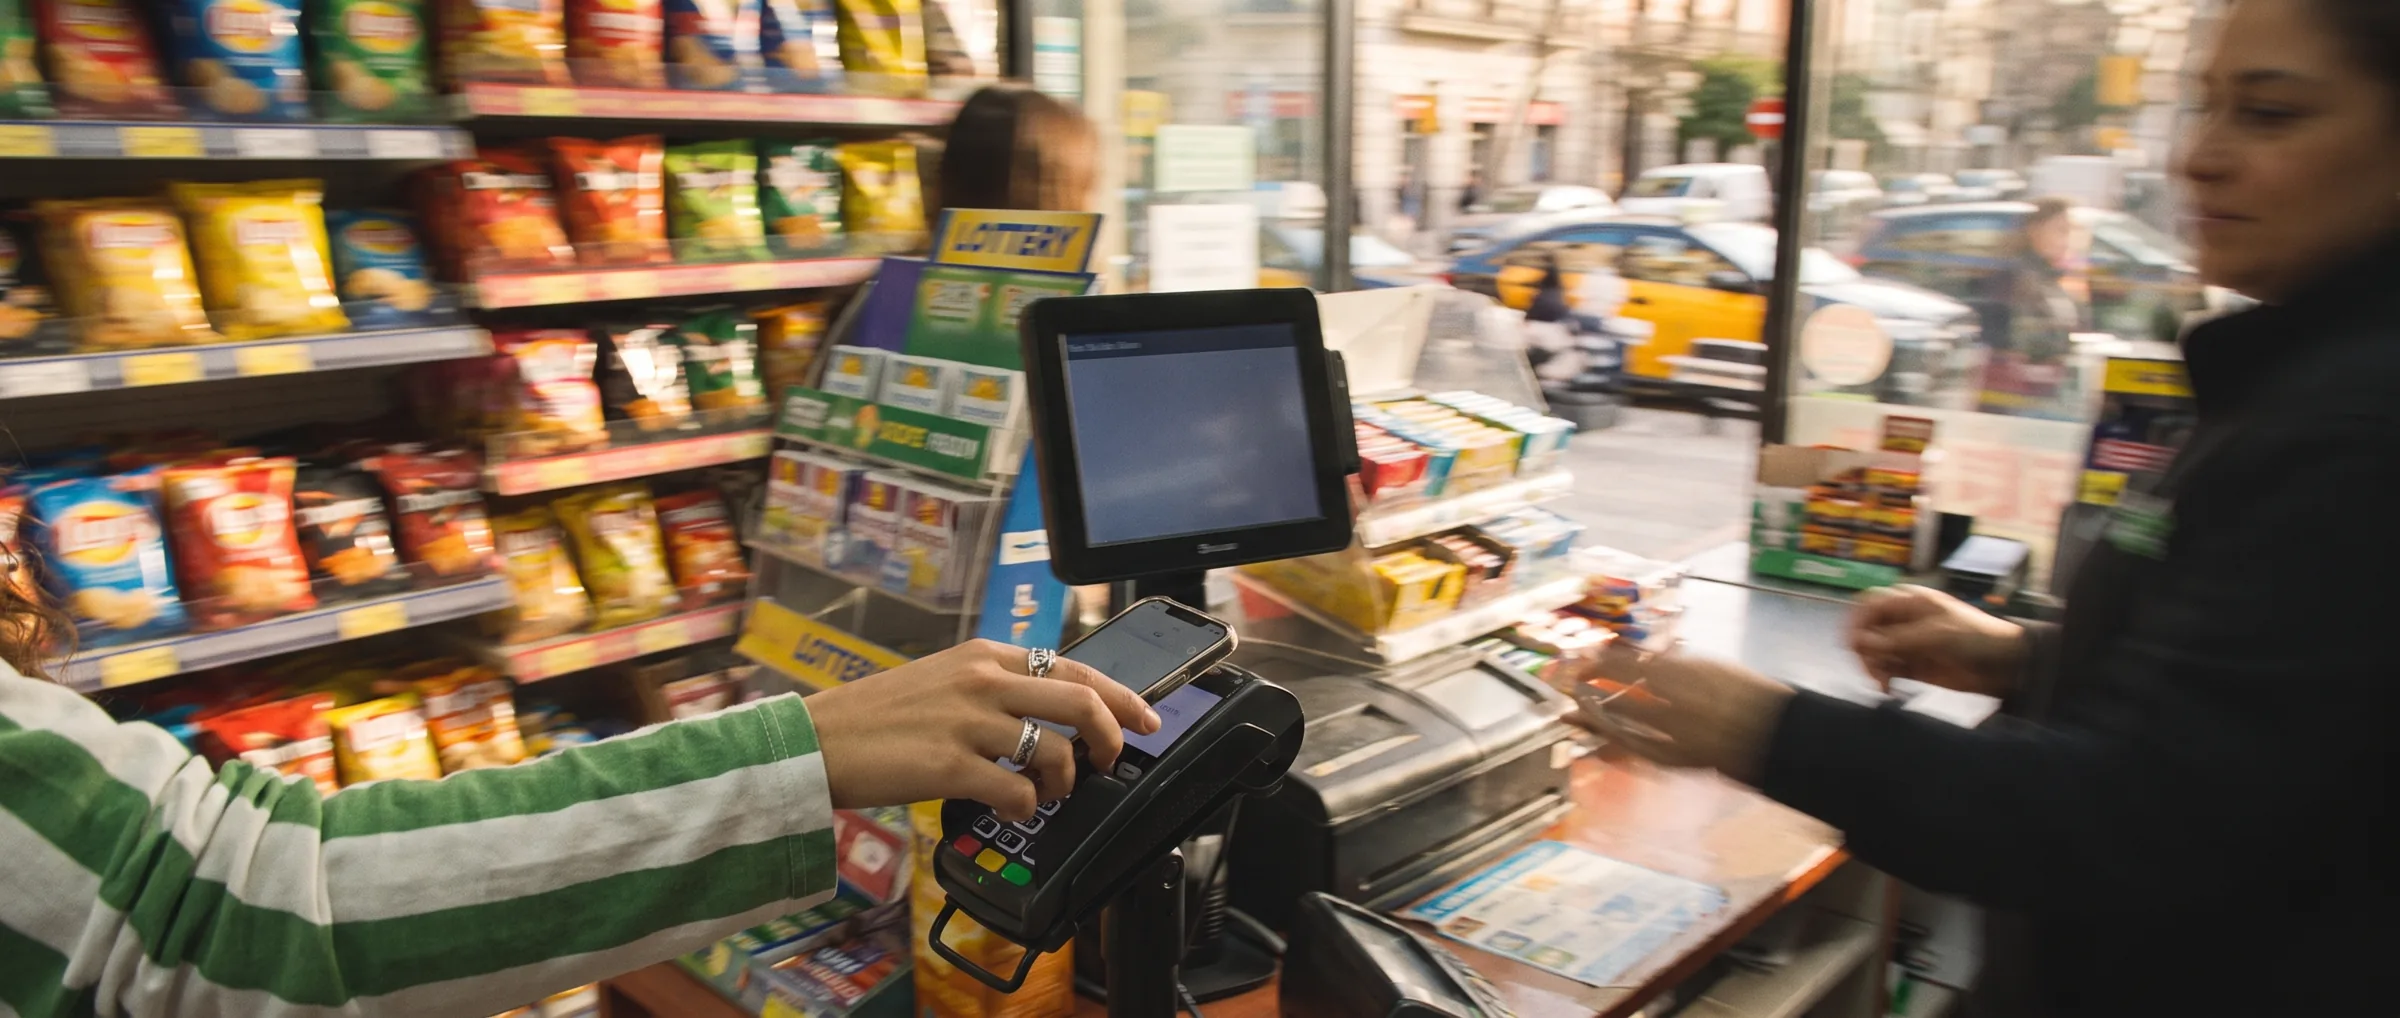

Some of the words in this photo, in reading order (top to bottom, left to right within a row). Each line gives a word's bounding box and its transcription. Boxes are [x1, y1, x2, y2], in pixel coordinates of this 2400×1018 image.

[953, 221, 1081, 259] LOTTERY
[793, 632, 891, 683] LOTTER
[977, 818, 989, 828] F
